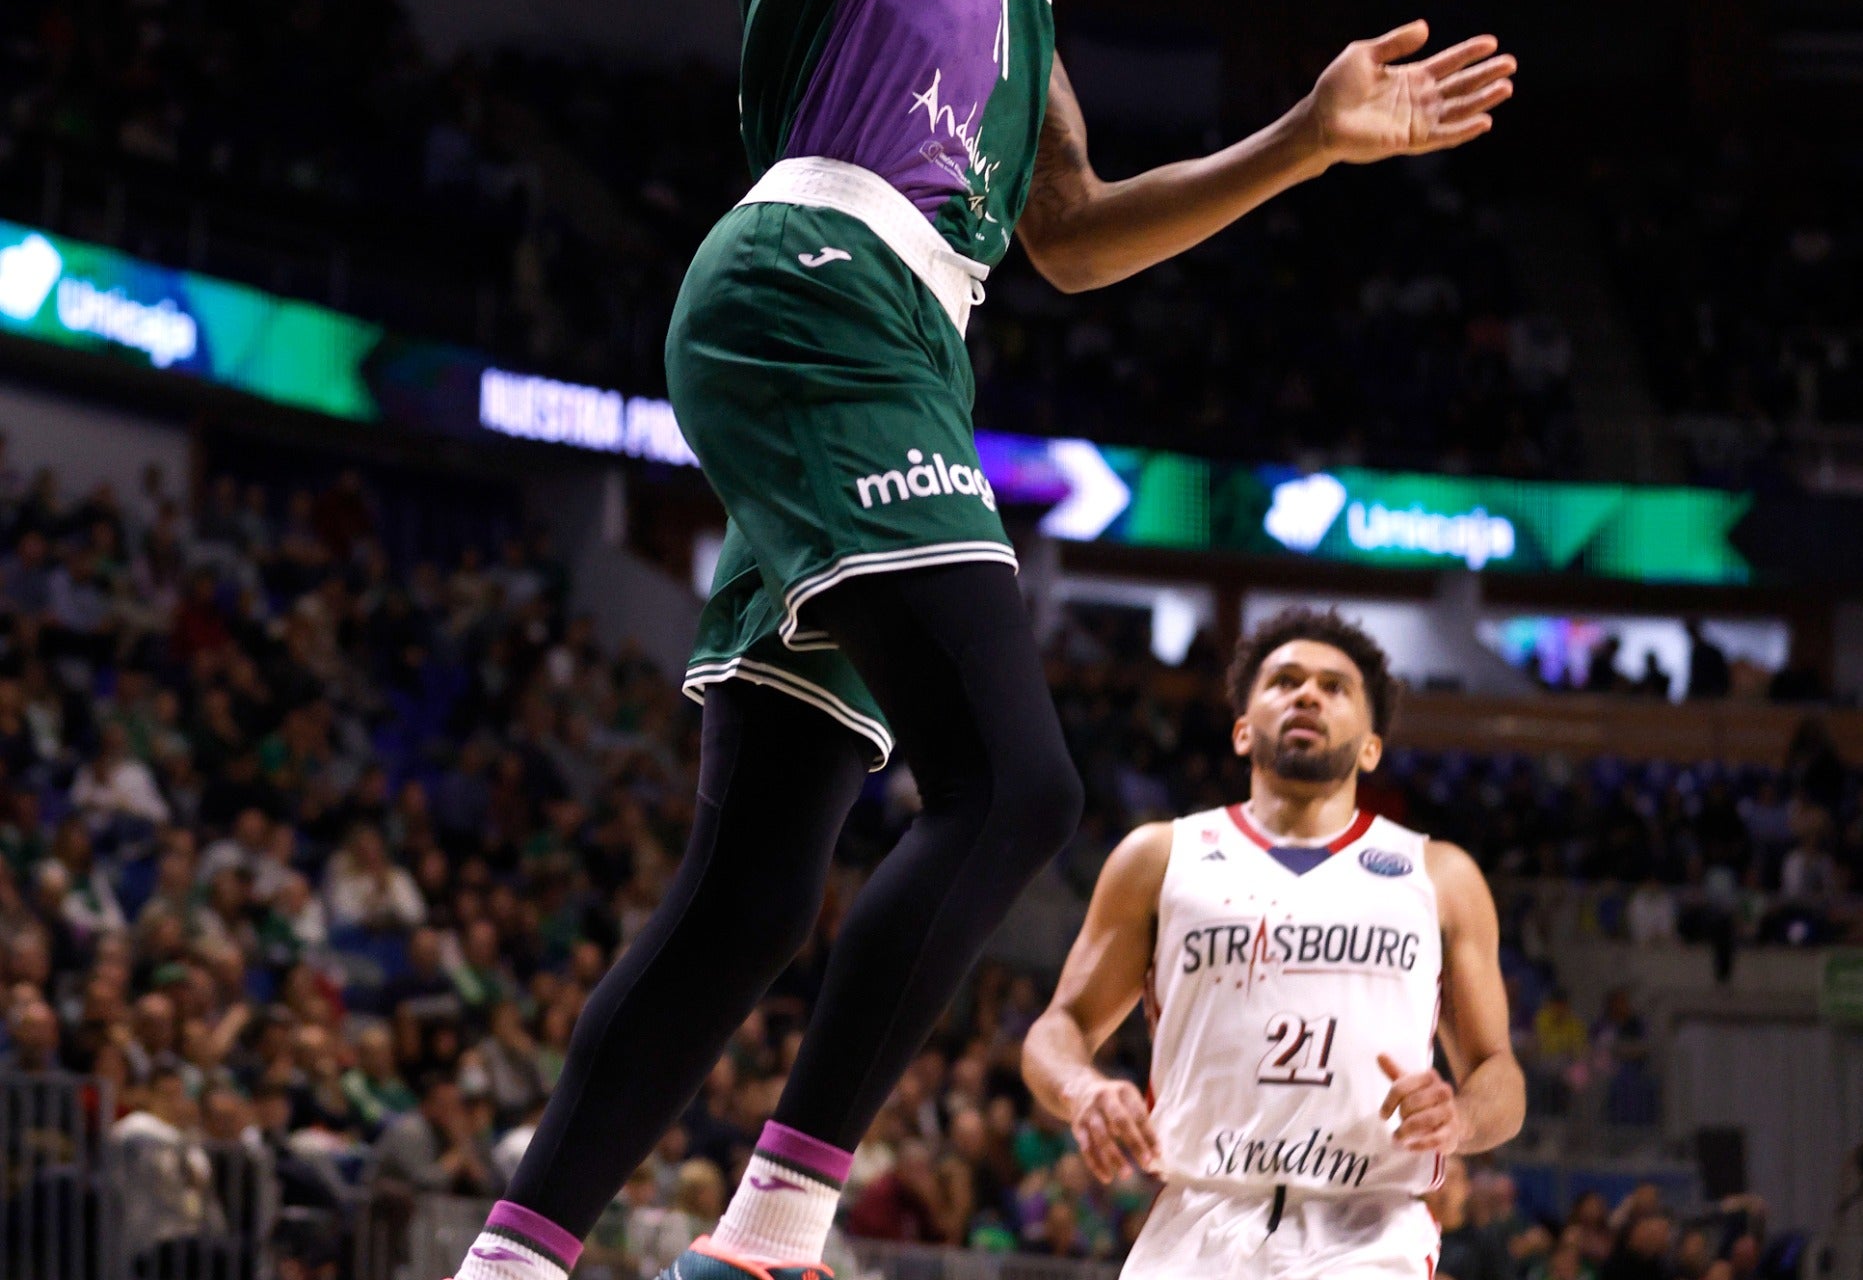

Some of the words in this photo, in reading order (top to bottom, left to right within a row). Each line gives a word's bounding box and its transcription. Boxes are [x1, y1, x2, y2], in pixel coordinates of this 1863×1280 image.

[1182, 915, 1421, 988] STRASBOURG
[1256, 1011, 1339, 1087] 21
[1205, 1126, 1371, 1188] Stradim
